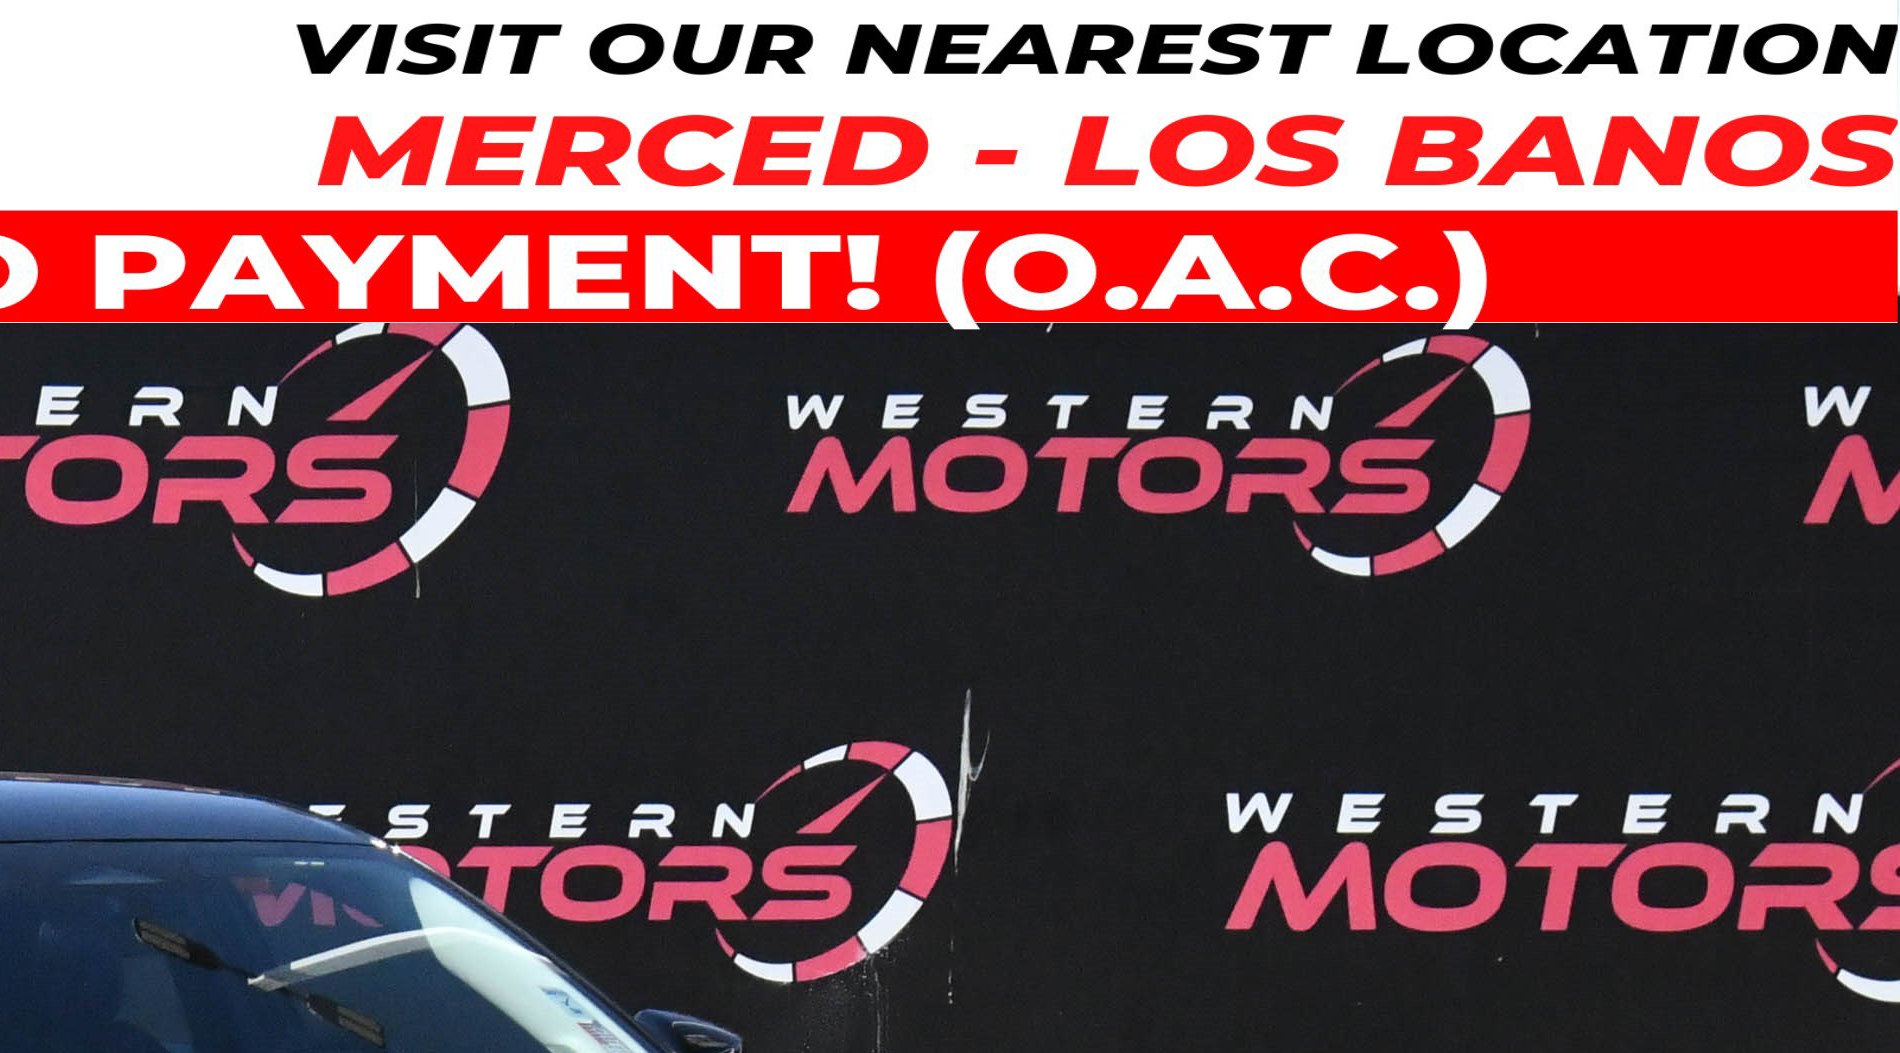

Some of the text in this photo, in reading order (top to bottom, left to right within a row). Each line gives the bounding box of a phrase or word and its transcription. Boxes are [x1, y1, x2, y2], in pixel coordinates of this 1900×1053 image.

[787, 394, 1334, 431] WESTERN
[787, 435, 1435, 515] MOTORS
[309, 803, 756, 841] STERN
[1226, 793, 1864, 834] WESTERN
